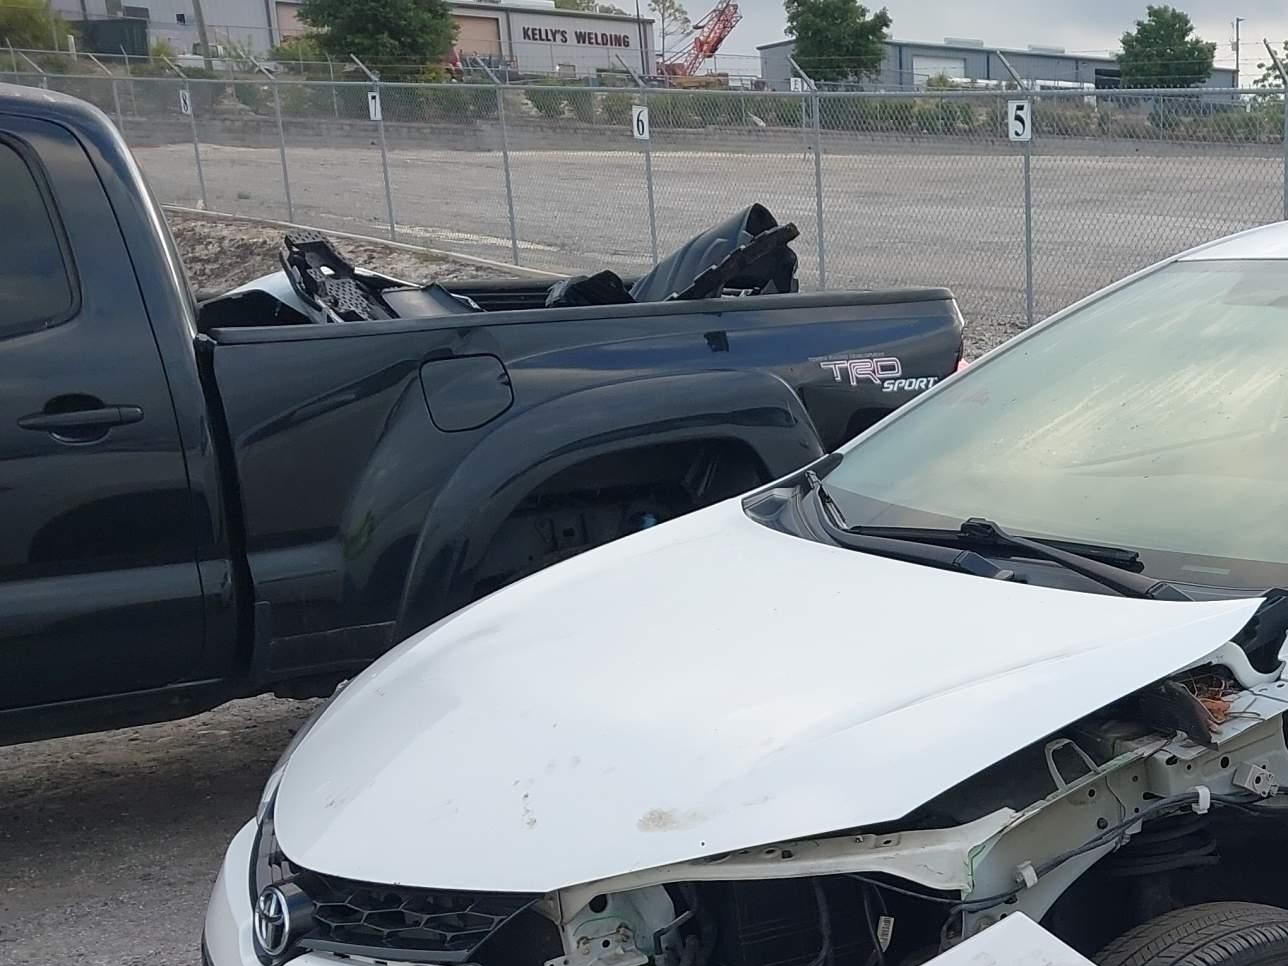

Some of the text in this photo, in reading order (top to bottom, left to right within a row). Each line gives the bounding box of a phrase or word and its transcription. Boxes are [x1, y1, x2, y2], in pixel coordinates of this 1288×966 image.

[522, 26, 630, 48] KELLY'S WELDING
[181, 92, 189, 112] 8
[371, 95, 377, 118] 7
[636, 109, 646, 136] 6
[1014, 104, 1026, 137] 5
[820, 357, 902, 386] TRD
[882, 377, 938, 392] SPORT
